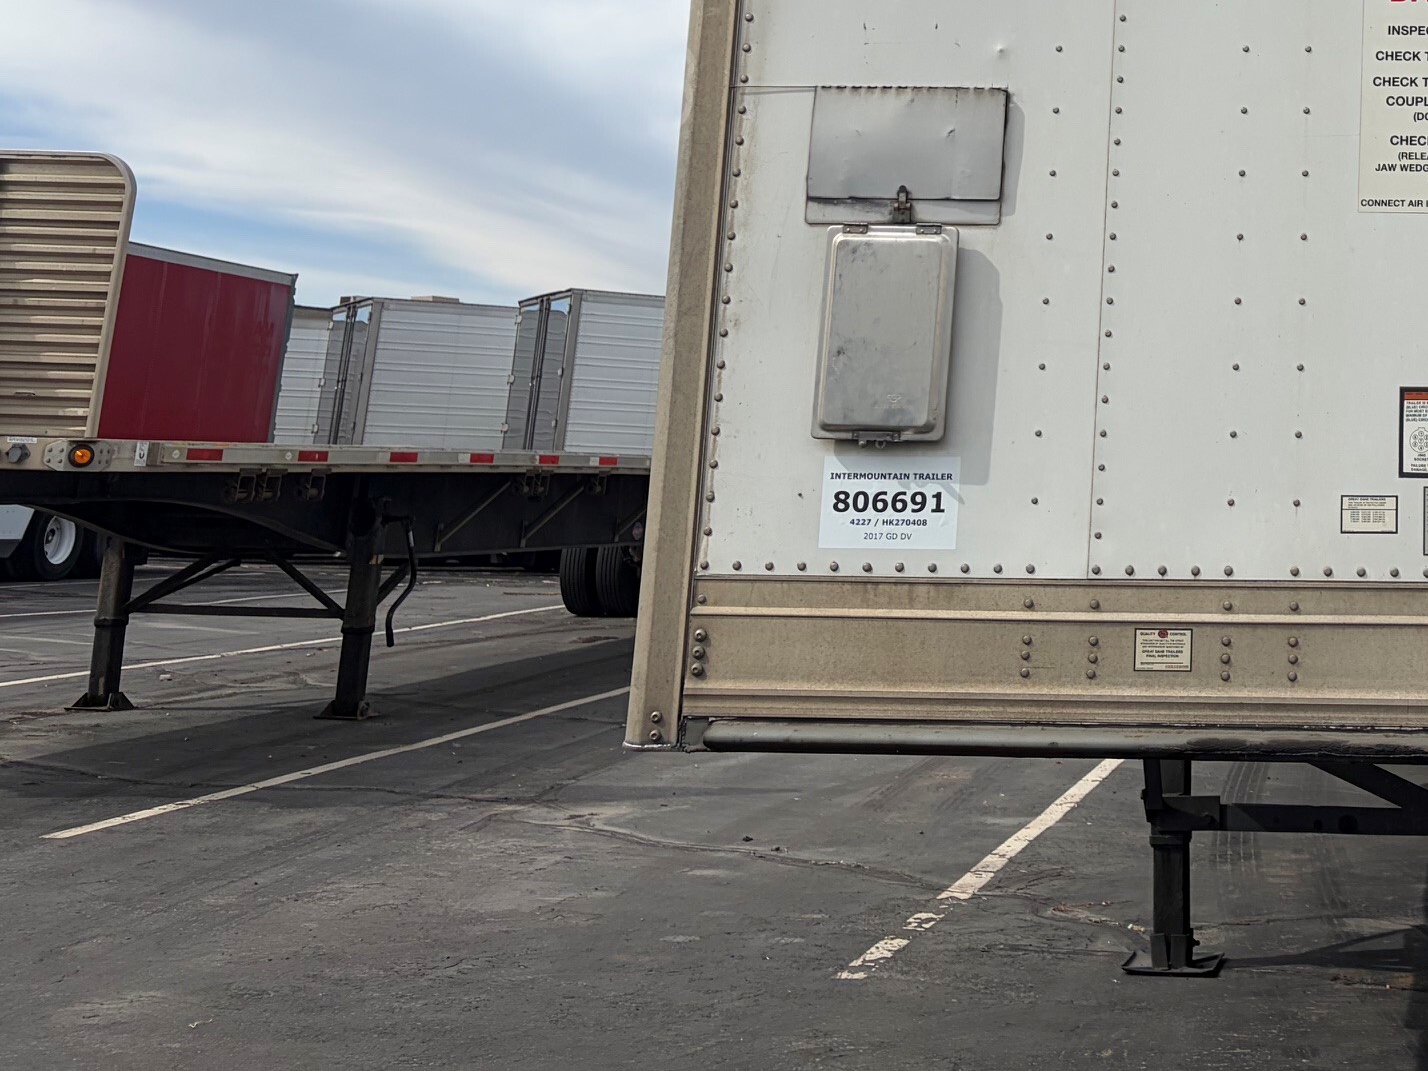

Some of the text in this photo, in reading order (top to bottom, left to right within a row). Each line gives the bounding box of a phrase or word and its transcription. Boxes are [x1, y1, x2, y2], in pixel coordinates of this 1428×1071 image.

[1375, 50, 1420, 62] CHECK
[1372, 76, 1418, 88] CHECK
[1375, 163, 1397, 173] JAW
[1360, 198, 1404, 209] CONNECT
[1407, 199, 1423, 209] AIR
[830, 472, 953, 481] INTERMOUNTAIN TRAILER
[832, 490, 945, 513] 806691
[849, 518, 928, 526] 4227 / HK270408
[863, 532, 883, 540] 2017
